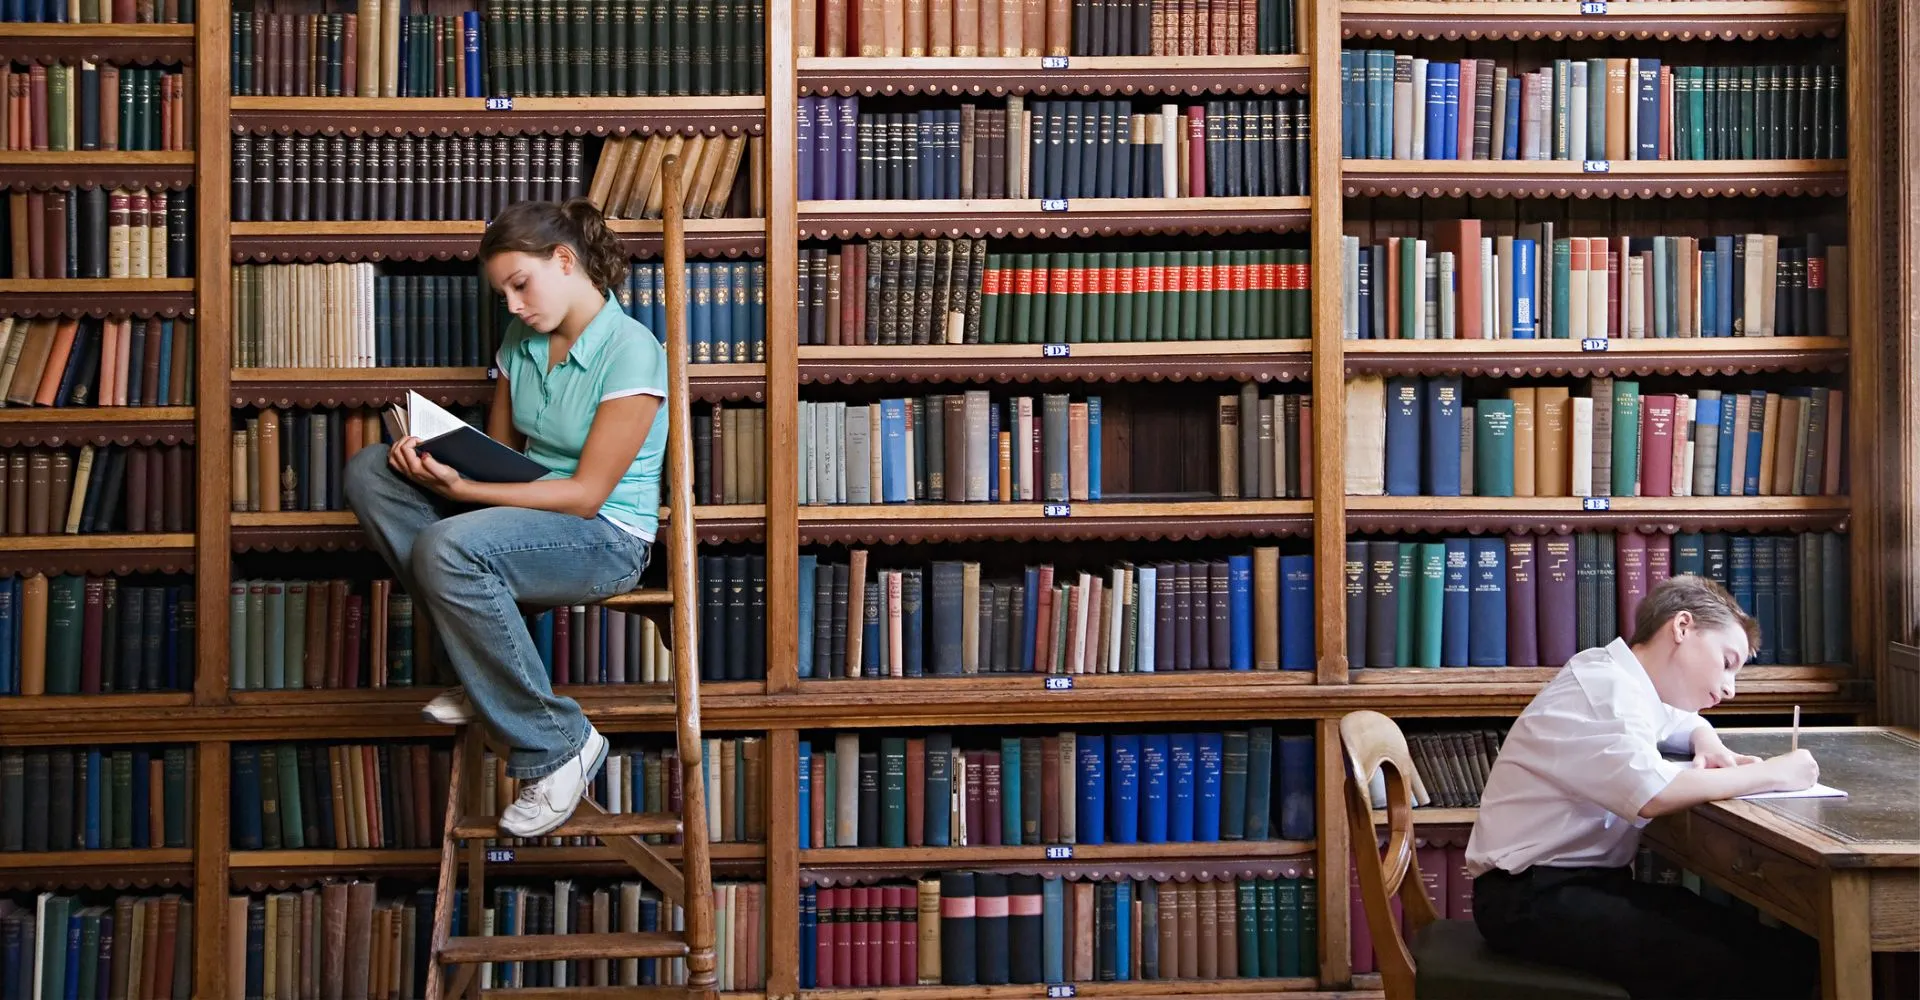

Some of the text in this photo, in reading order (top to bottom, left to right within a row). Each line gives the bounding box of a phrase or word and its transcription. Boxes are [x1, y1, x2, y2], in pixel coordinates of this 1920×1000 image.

[1052, 59, 1060, 67] B
[495, 100, 504, 108] B
[1592, 162, 1600, 170] C
[1051, 201, 1059, 209] C
[1591, 341, 1599, 349] D
[1053, 347, 1061, 355] D
[1593, 500, 1600, 508] E
[1054, 507, 1061, 515] F
[1054, 680, 1062, 688] G
[1055, 848, 1063, 857] H
